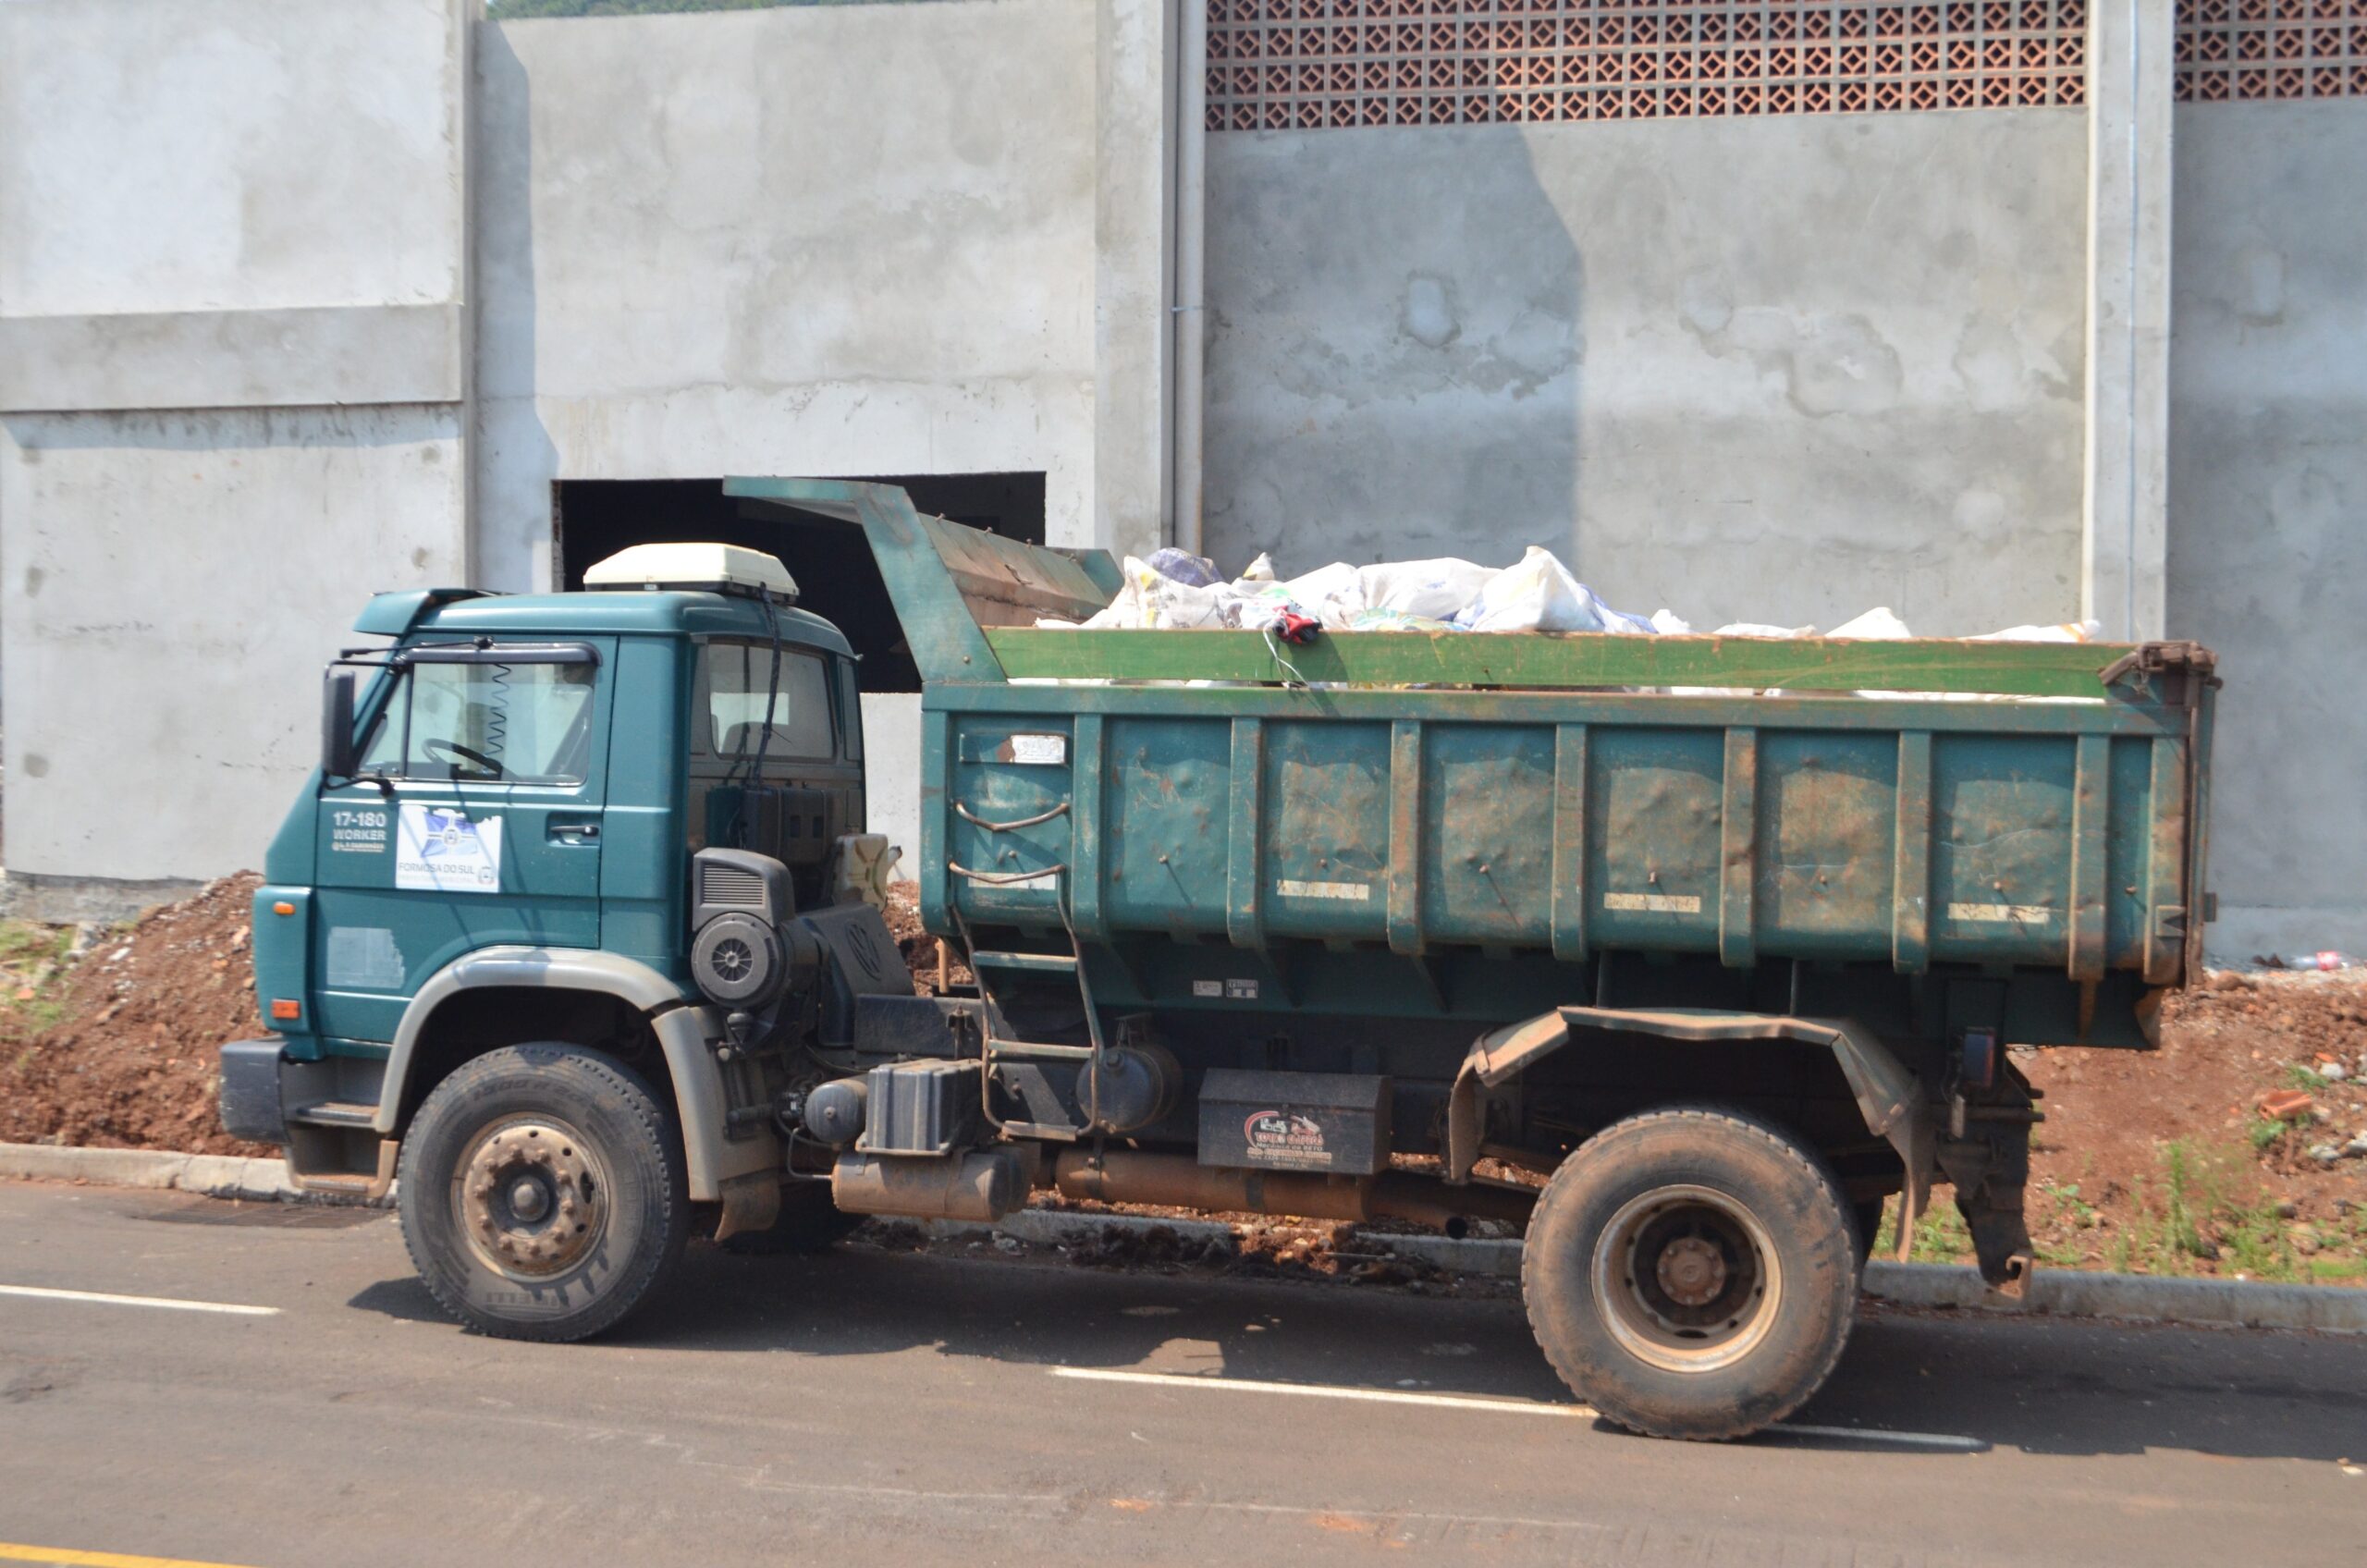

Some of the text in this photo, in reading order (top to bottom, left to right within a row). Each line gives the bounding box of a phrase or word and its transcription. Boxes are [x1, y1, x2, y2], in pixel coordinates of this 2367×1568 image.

[333, 811, 387, 827] 17-180
[333, 828, 386, 840] WORKER
[399, 862, 474, 874] FORMOSA DO SUL
